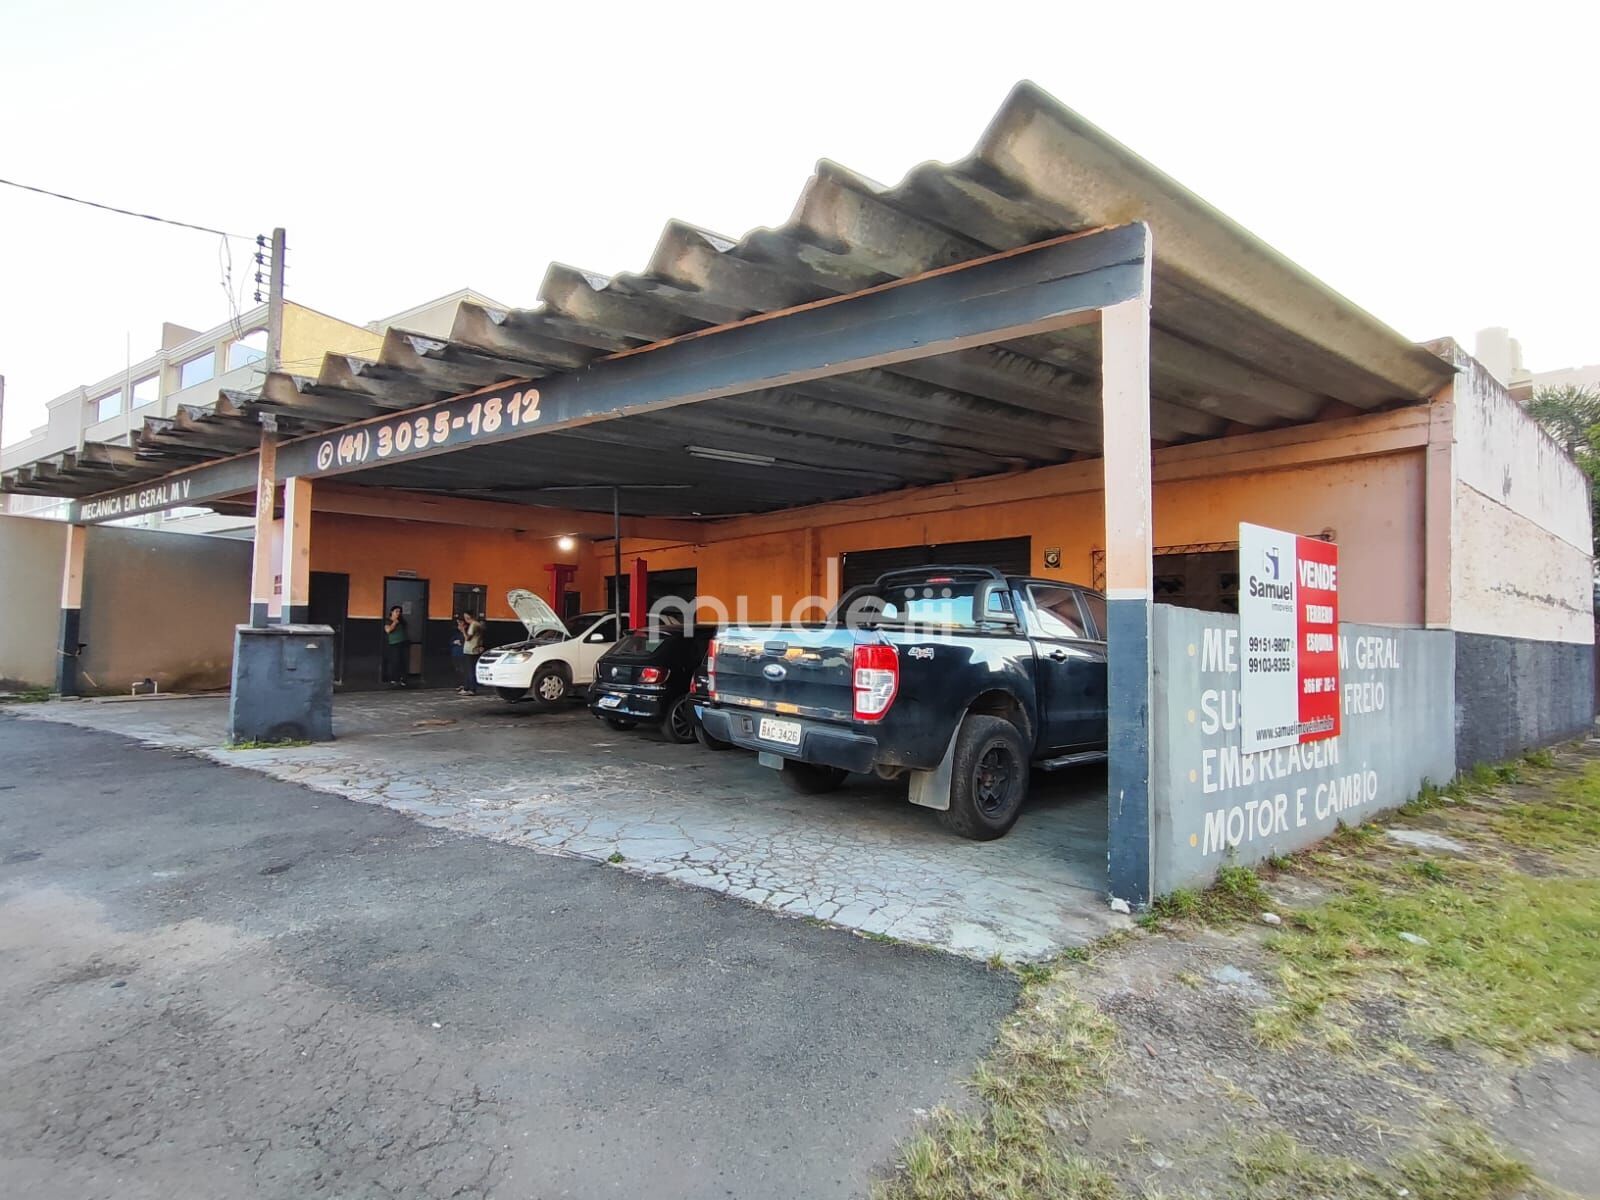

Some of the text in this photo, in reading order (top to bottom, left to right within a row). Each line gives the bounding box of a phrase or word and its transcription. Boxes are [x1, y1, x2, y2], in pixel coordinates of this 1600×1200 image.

[337, 388, 541, 466] (41) 3035-1812
[124, 493, 136, 512] EM
[139, 485, 168, 508] GERAL
[171, 482, 179, 500] M
[183, 479, 190, 498] V
[1249, 575, 1293, 600] Samuel
[1298, 558, 1337, 591] VENDE
[1248, 636, 1290, 652] 99151-9807
[1356, 636, 1400, 670] GERAL
[1248, 657, 1290, 673] 99103-9355
[1202, 737, 1339, 794] EMBREAGEM
[1202, 793, 1289, 856] MOTOR
[1296, 788, 1307, 827] E
